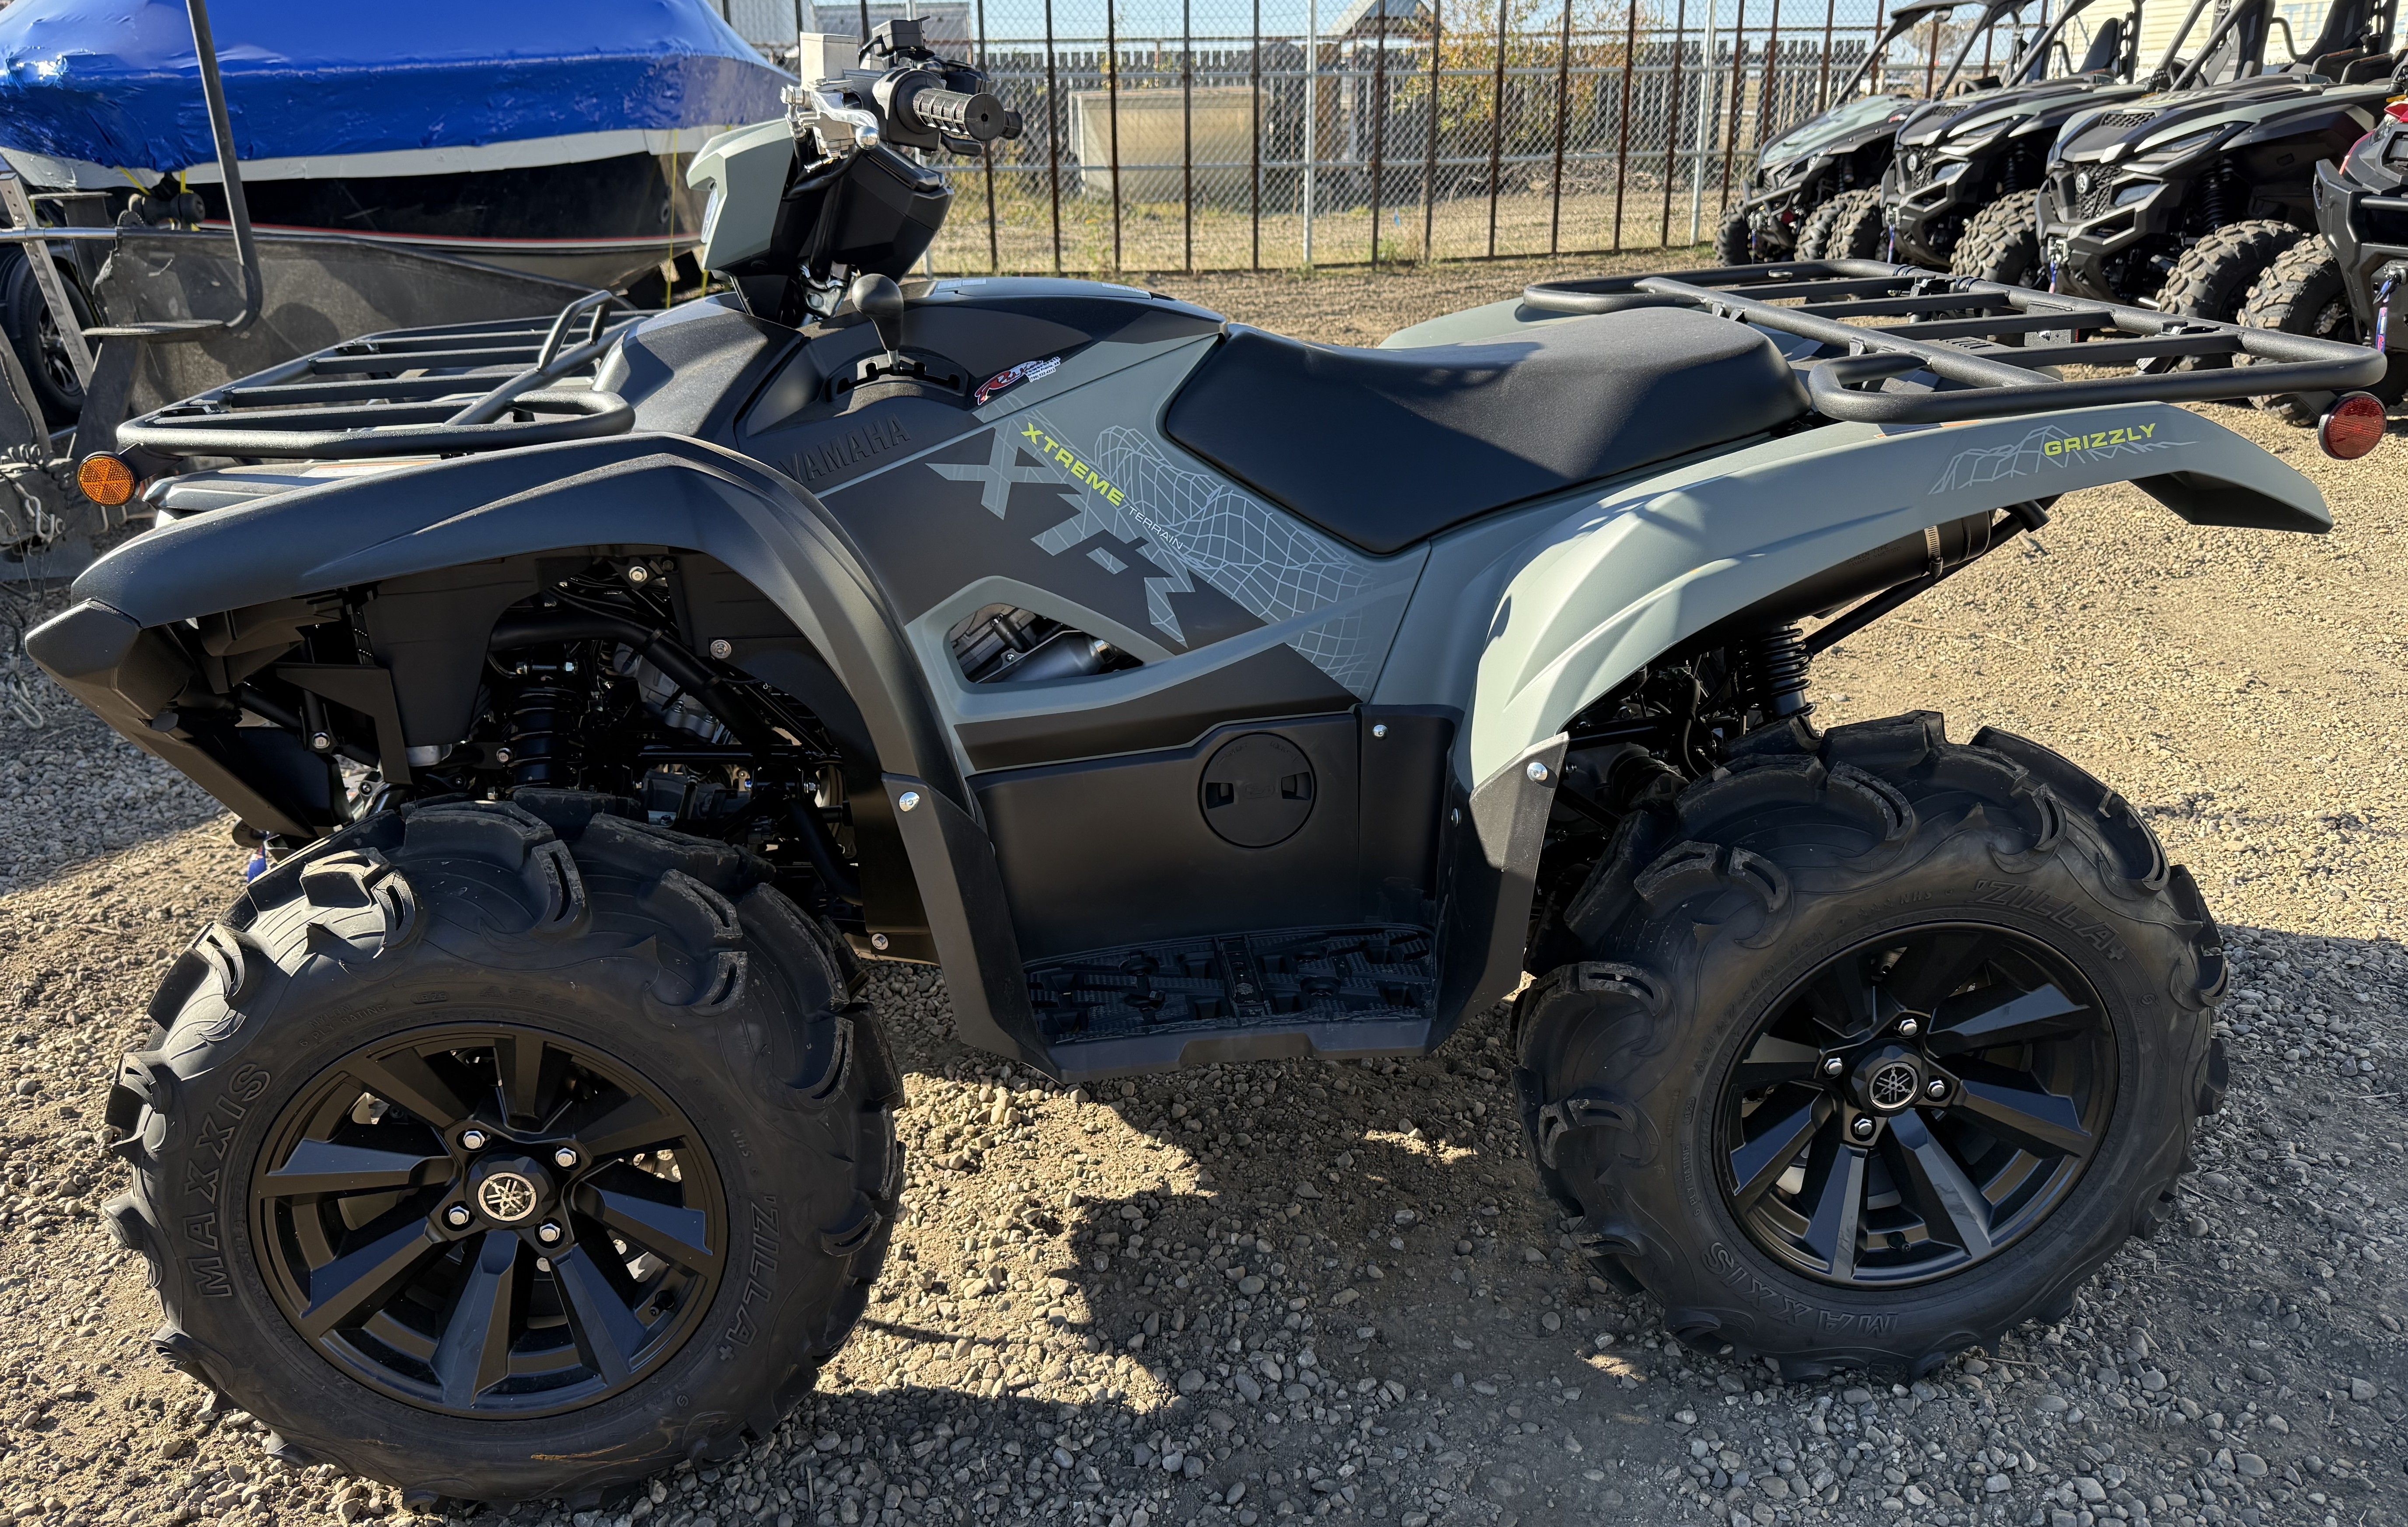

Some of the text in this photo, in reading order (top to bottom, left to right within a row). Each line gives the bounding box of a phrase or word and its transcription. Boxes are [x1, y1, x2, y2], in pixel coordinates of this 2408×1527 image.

[778, 412, 912, 483] YAMAHA
[2044, 423, 2156, 456] GRIZZLY
[1021, 422, 1183, 550] XTREME TERRAIN
[308, 1004, 352, 1029] NYLON
[311, 1023, 335, 1040] PLY
[340, 1004, 387, 1025] RATING
[183, 1063, 272, 1298] MAXXIS
[1682, 1145, 1692, 1182] RATING
[1687, 1186, 1698, 1206] PLY
[1701, 1241, 1899, 1340] MAXXIS
